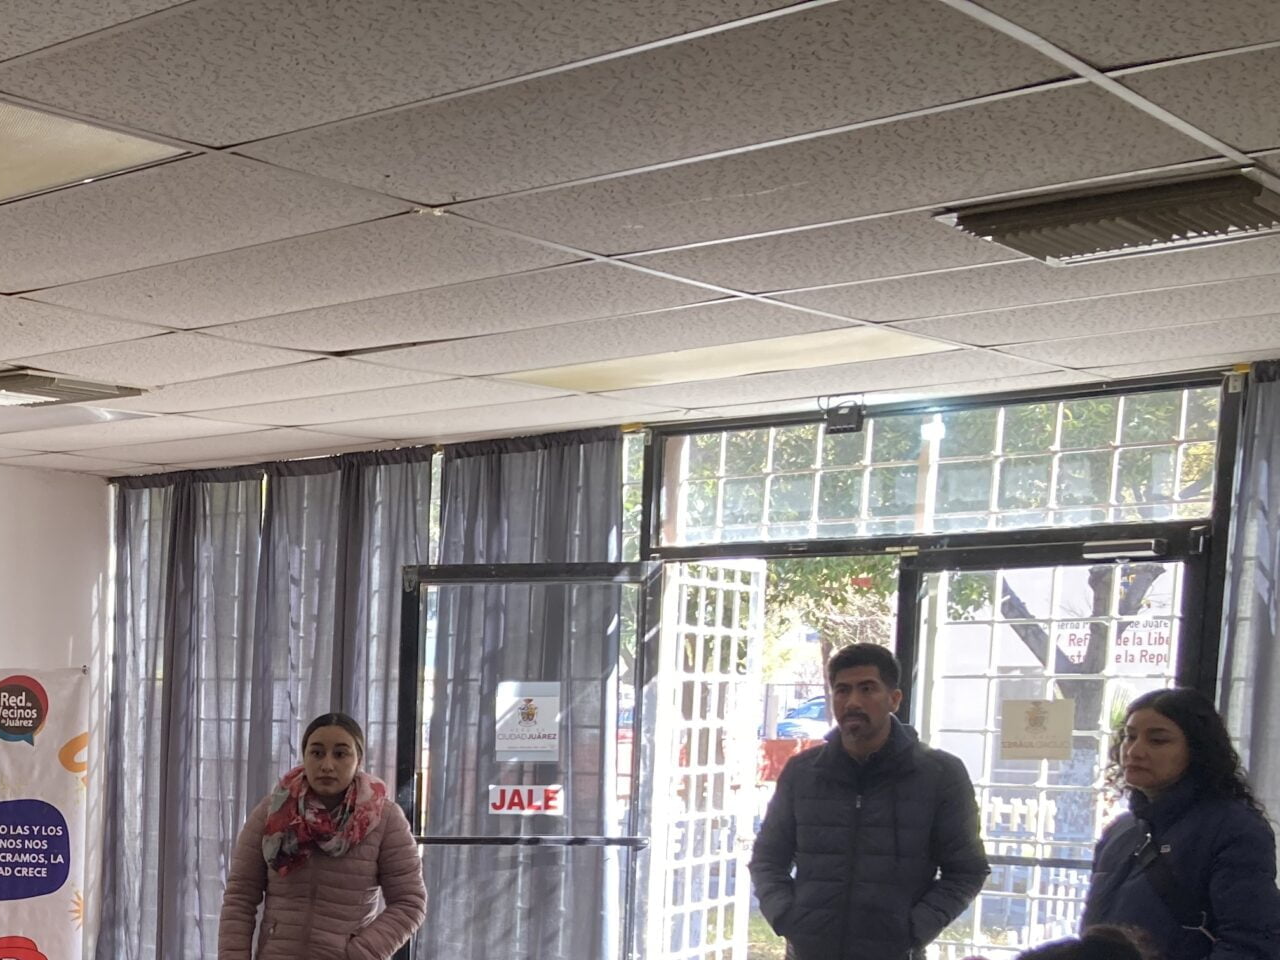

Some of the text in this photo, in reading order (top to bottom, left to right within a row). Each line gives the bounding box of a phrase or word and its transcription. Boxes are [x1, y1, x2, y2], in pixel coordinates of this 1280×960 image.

[0, 691, 26, 707] Red
[5, 717, 33, 727] Juárez
[491, 788, 559, 811] JALE
[10, 825, 29, 835] LAS
[32, 825, 40, 835] Y
[42, 826, 63, 836] LOS
[25, 839, 48, 849] NOS
[50, 854, 64, 864] LA
[14, 867, 48, 877] CRECE
